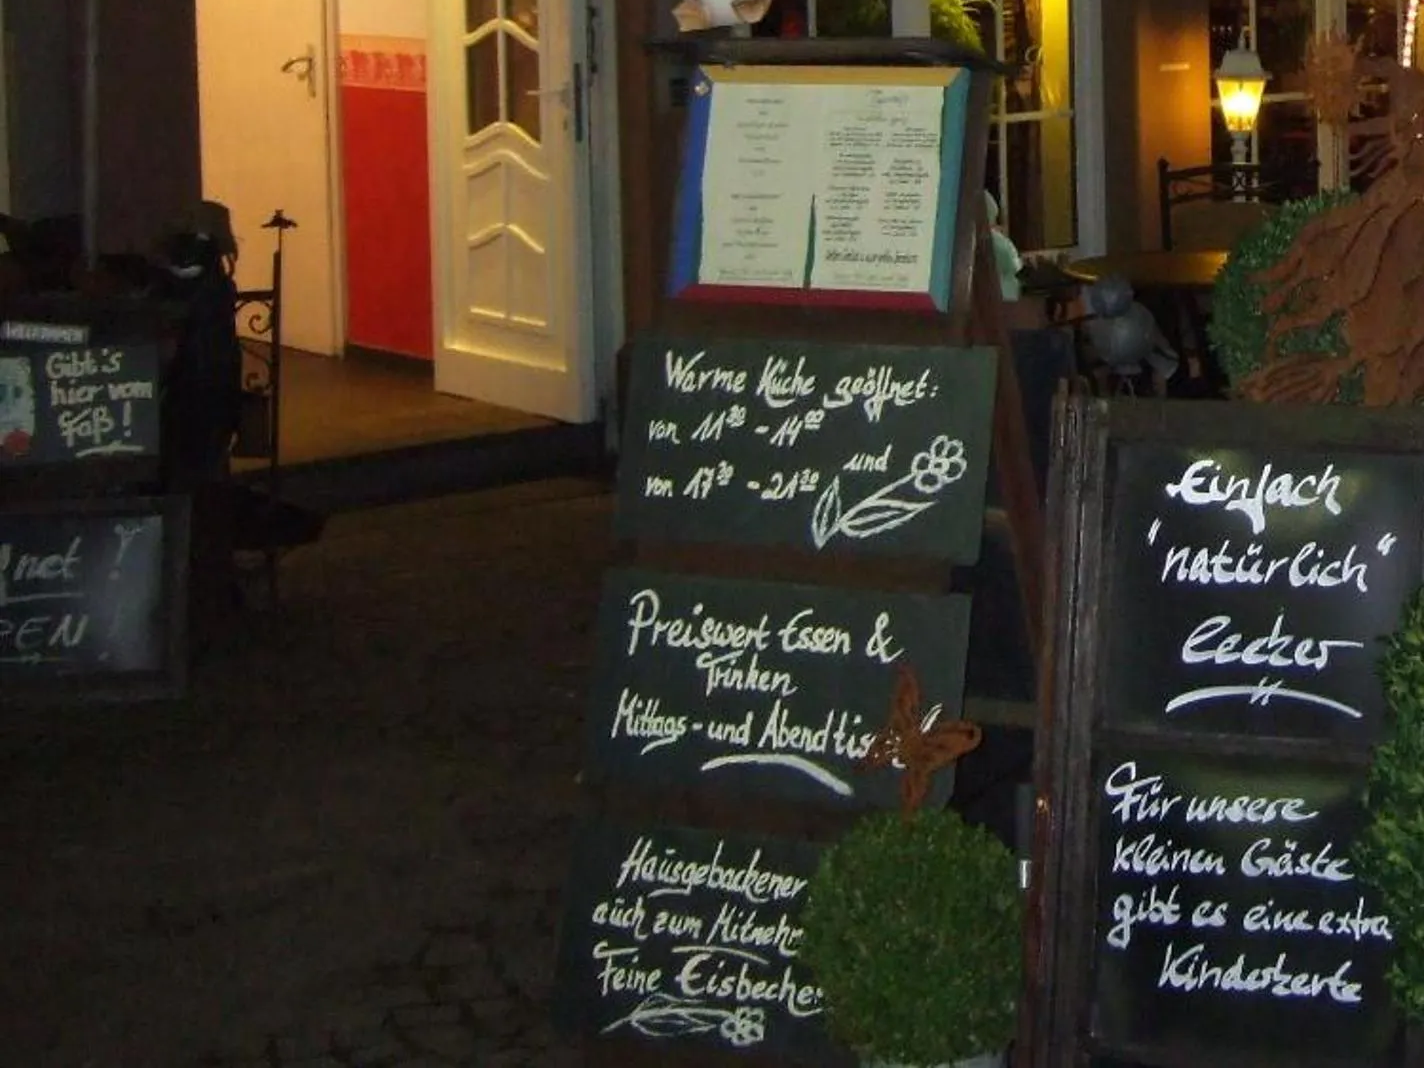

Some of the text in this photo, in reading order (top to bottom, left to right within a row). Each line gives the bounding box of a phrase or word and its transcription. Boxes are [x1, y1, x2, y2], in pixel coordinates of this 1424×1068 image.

[665, 350, 748, 394] Warme
[754, 355, 816, 408] Küche
[648, 419, 680, 444] von
[843, 443, 893, 472] und
[644, 475, 673, 497] von
[1165, 459, 1342, 533] Einfach
[628, 588, 905, 663] Preiswert Essen &
[696, 649, 799, 695] Trinken
[706, 711, 753, 747] und
[1104, 761, 1320, 823] Für unsere
[1240, 838, 1355, 881] Gäste
[652, 909, 701, 938] zum
[1106, 883, 1393, 949] gibt es eine extra
[592, 941, 662, 996] Feine
